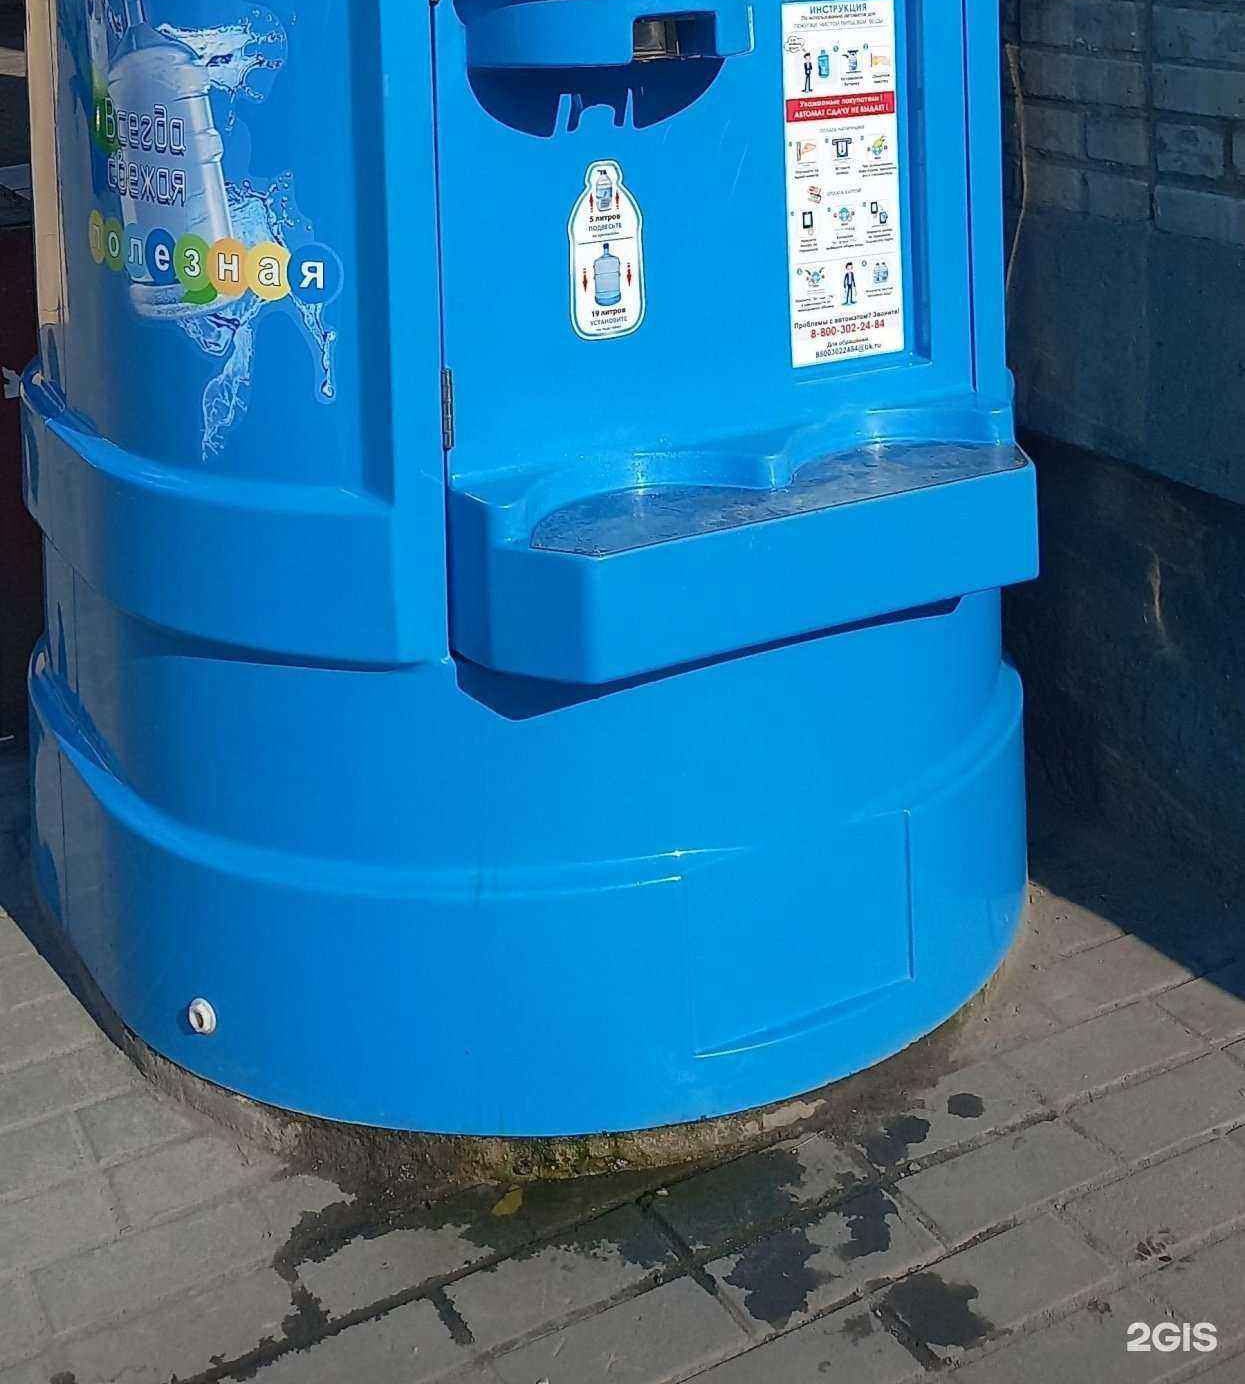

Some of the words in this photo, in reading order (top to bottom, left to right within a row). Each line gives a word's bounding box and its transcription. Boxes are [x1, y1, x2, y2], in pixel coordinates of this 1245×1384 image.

[809, 3, 867, 14] ИНСТРУКЦИЯ
[589, 215, 594, 223] 5
[595, 214, 621, 222] литров
[591, 310, 600, 318] 19
[600, 307, 626, 316] литров
[794, 320, 828, 330] Проблемы
[810, 319, 885, 339] 8-800-302-24-84
